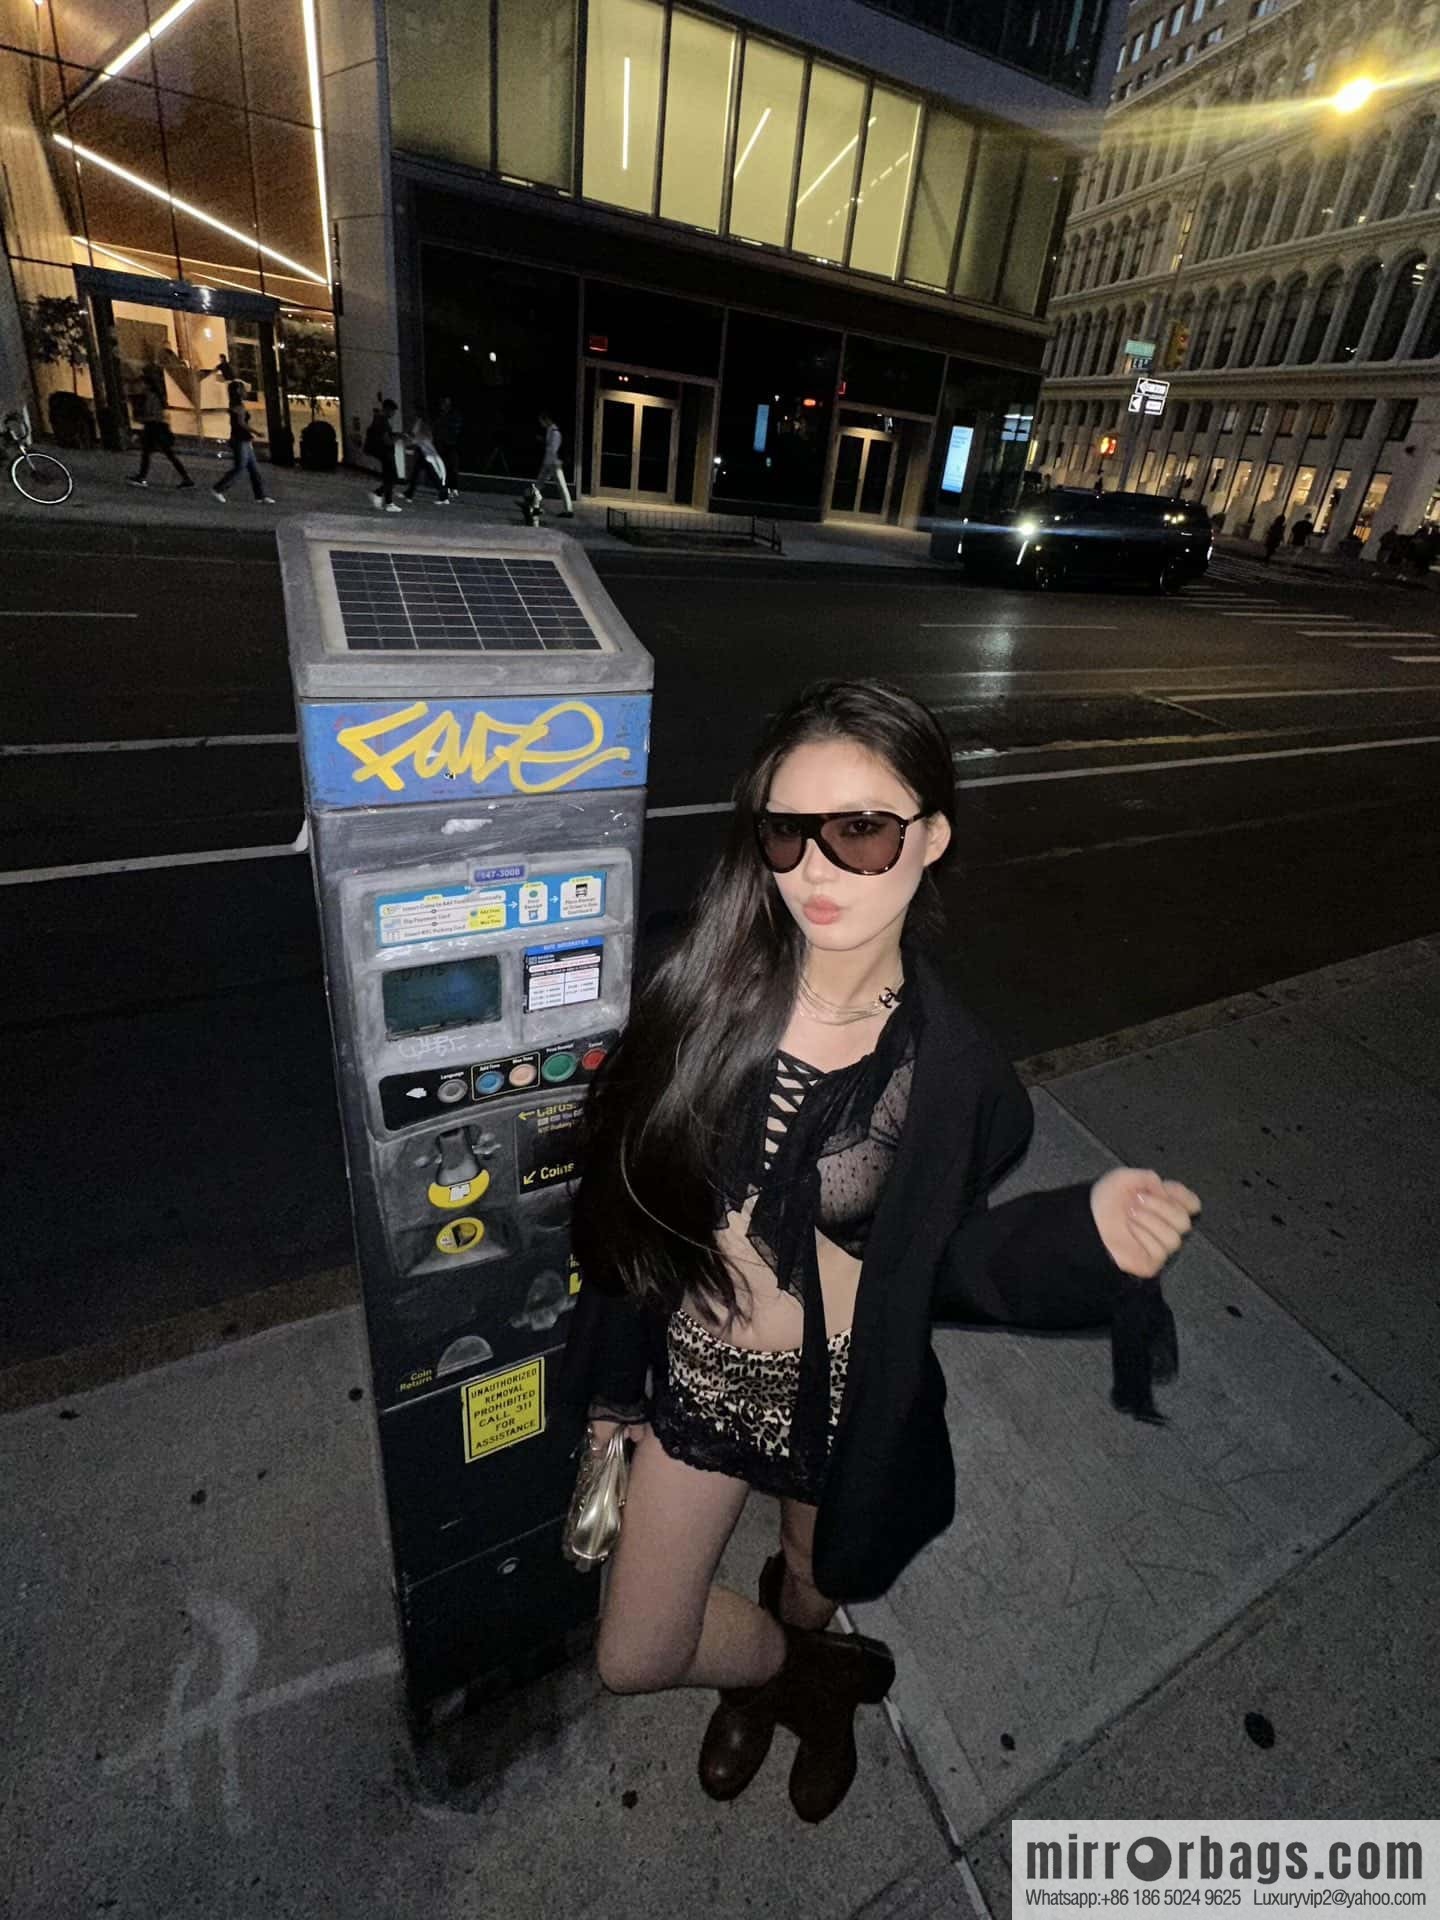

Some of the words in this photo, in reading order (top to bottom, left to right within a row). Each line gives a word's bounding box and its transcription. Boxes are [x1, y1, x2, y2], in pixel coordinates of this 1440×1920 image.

[540, 1162, 575, 1180] Coins
[471, 1367, 537, 1399] UNAUTHORIZED
[485, 1383, 523, 1404] REMOVAL
[474, 1390, 536, 1419] PROHIBITED
[479, 1410, 510, 1428] CALL
[516, 1400, 532, 1413] 311
[475, 1419, 535, 1449] ASSISTANCE
[496, 1417, 515, 1431] FOR
